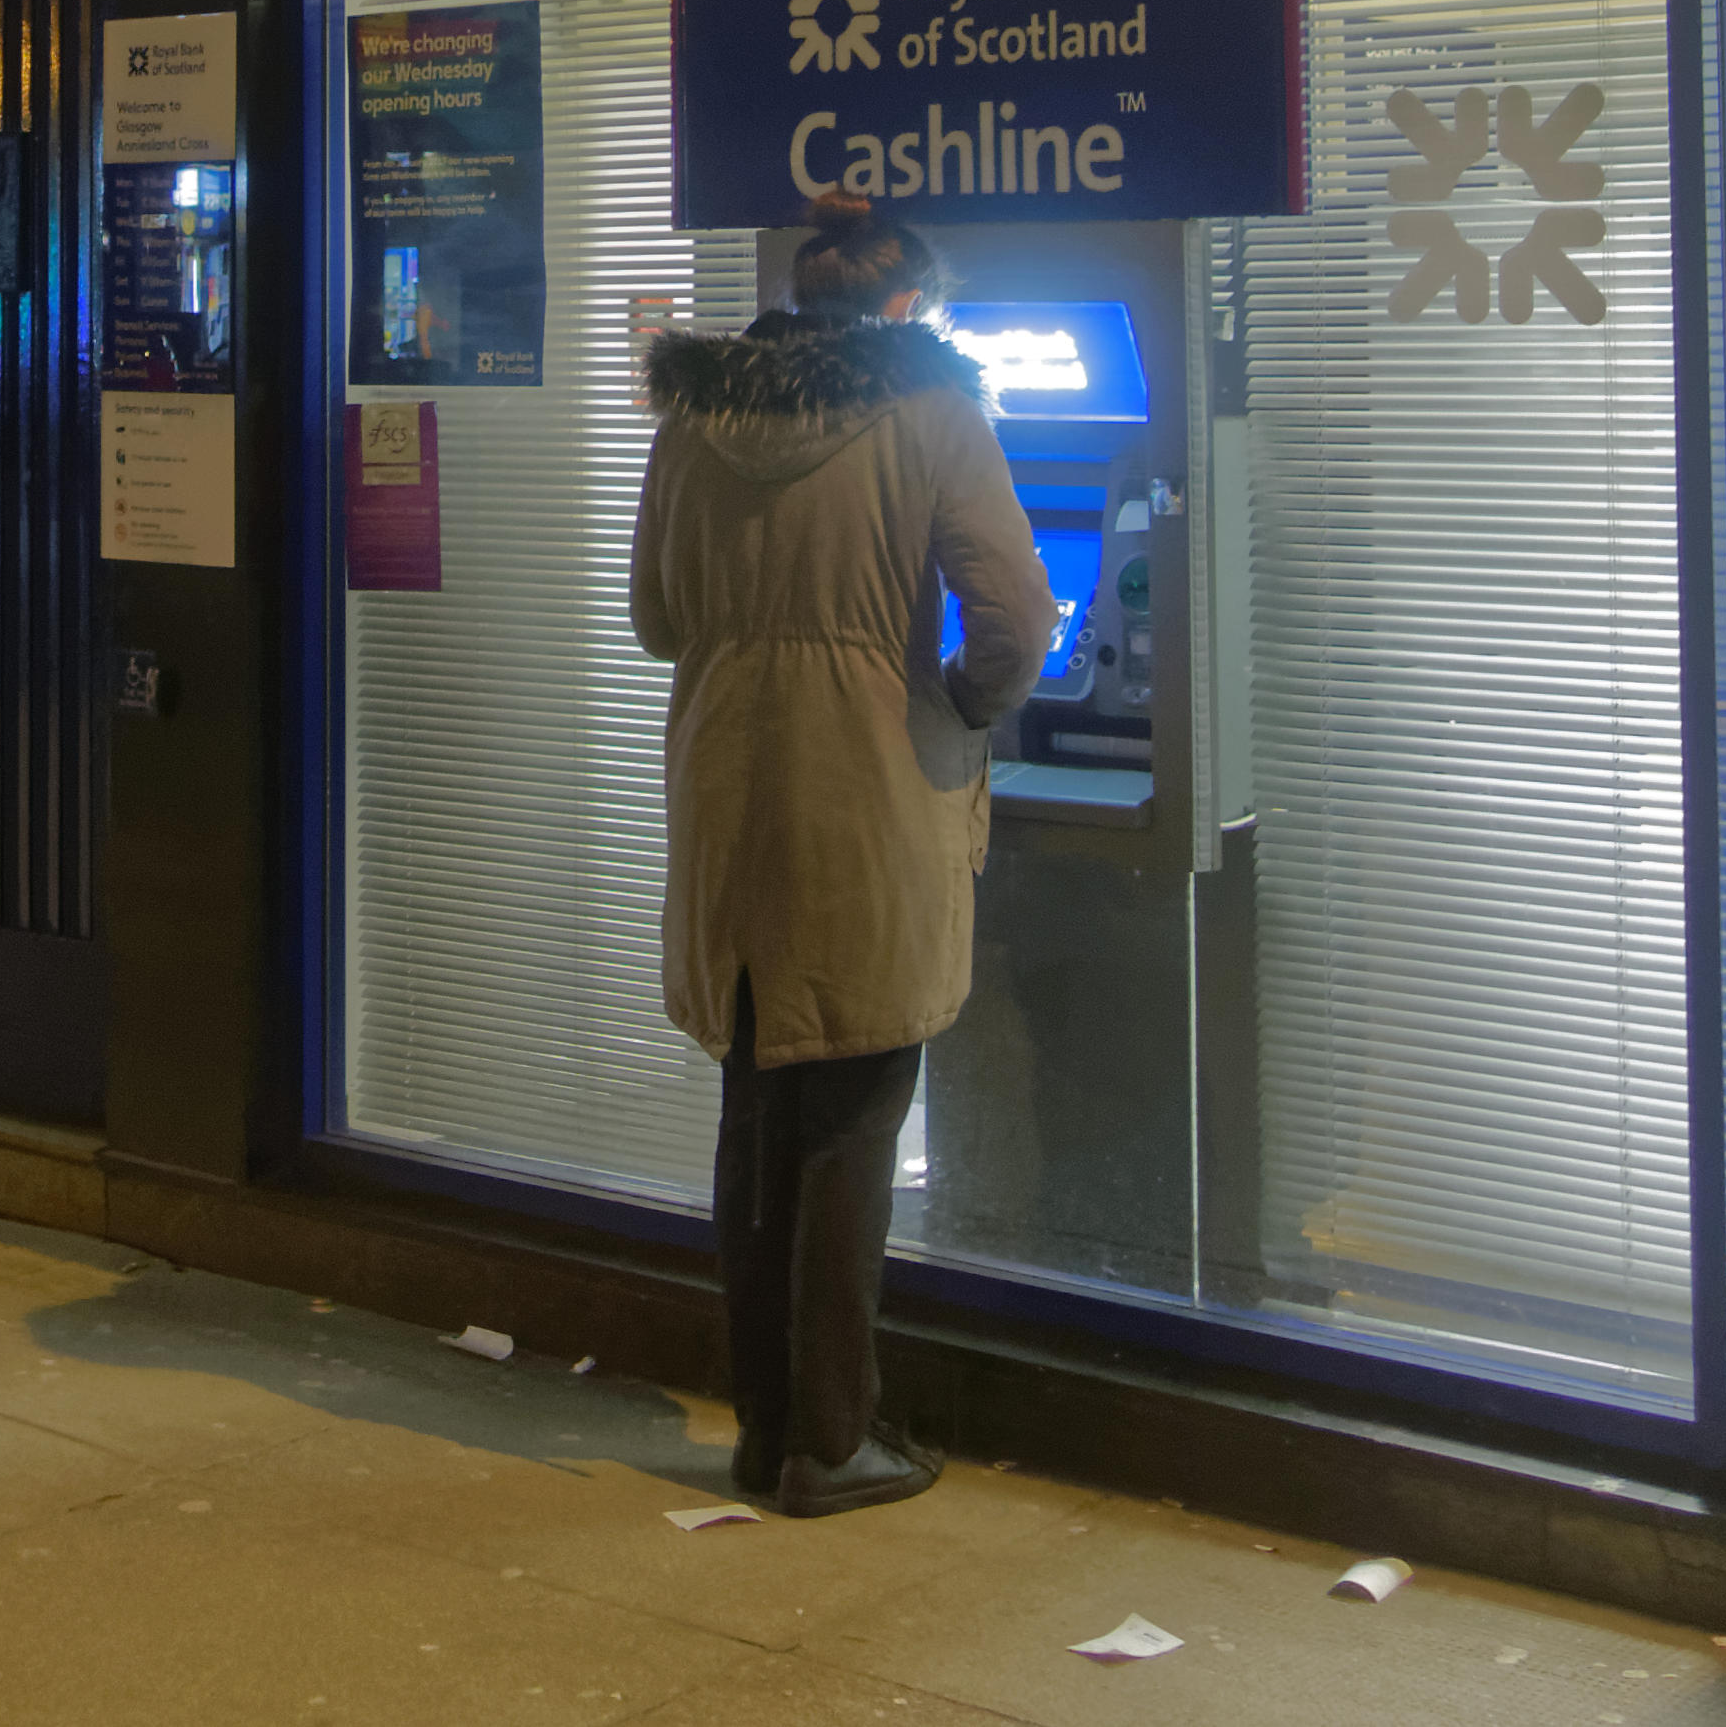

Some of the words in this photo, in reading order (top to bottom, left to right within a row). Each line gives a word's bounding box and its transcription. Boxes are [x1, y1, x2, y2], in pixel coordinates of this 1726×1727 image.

[361, 34, 410, 57] We're
[412, 28, 494, 56] changing
[897, 17, 945, 69] of
[953, 3, 1147, 66] Scotland
[151, 44, 179, 60] Royal
[180, 42, 205, 57] Bank
[151, 63, 162, 77] of
[163, 59, 206, 76] Scotland
[361, 68, 392, 85] our
[393, 57, 495, 83] Wednesday
[116, 101, 166, 114] Welcome
[168, 100, 182, 113] to
[361, 90, 431, 119] opening
[433, 88, 483, 109] hours
[116, 119, 164, 137] Glasgow
[115, 138, 177, 153] Anniesland
[177, 135, 210, 152] Cross
[789, 100, 1125, 199] Cashline
[114, 403, 142, 417] Safety
[368, 418, 408, 448] fscs
